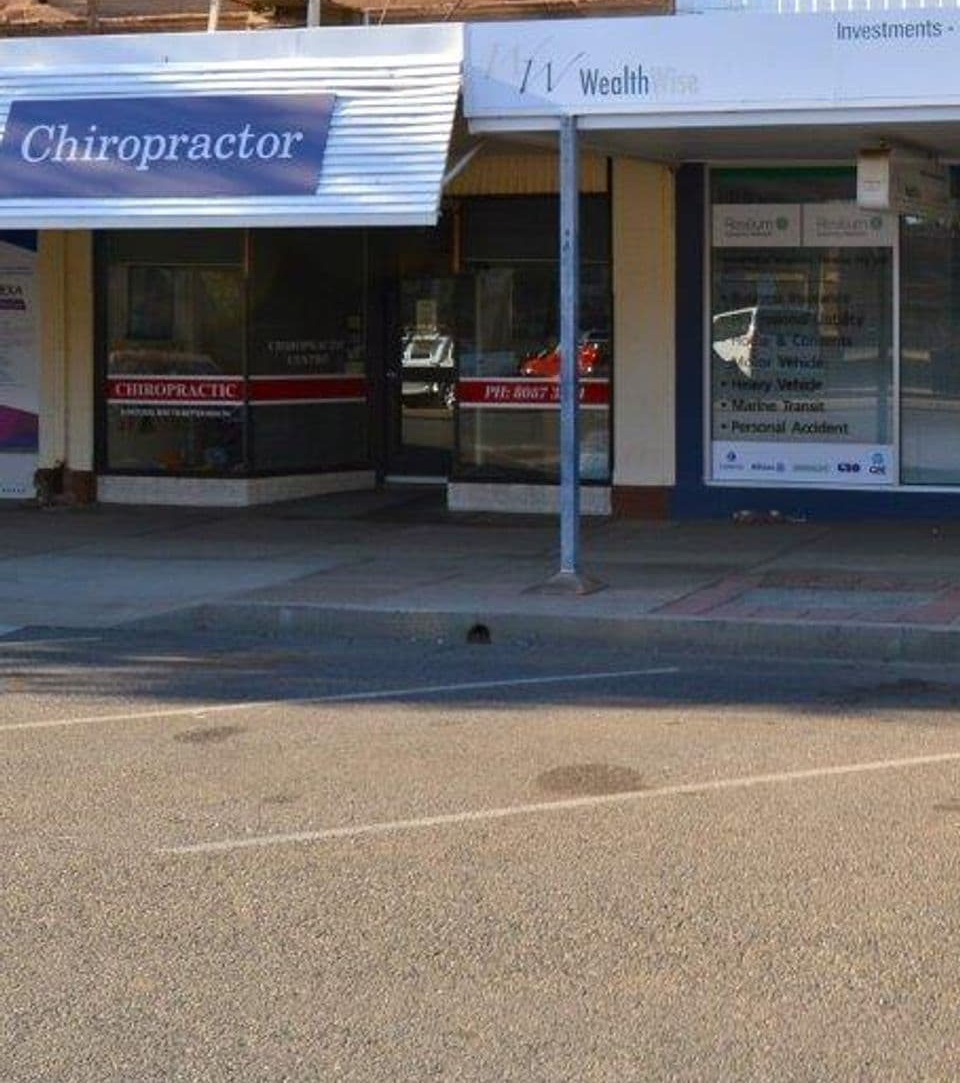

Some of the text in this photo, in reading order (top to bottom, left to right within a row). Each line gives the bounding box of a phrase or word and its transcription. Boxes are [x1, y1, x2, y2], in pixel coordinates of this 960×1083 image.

[836, 20, 943, 40] Investments
[20, 123, 304, 171] Chiropractor
[114, 382, 239, 398] CHIROPRACTIC
[731, 399, 825, 412] Marine Transit
[731, 421, 848, 435] Personal Accident
